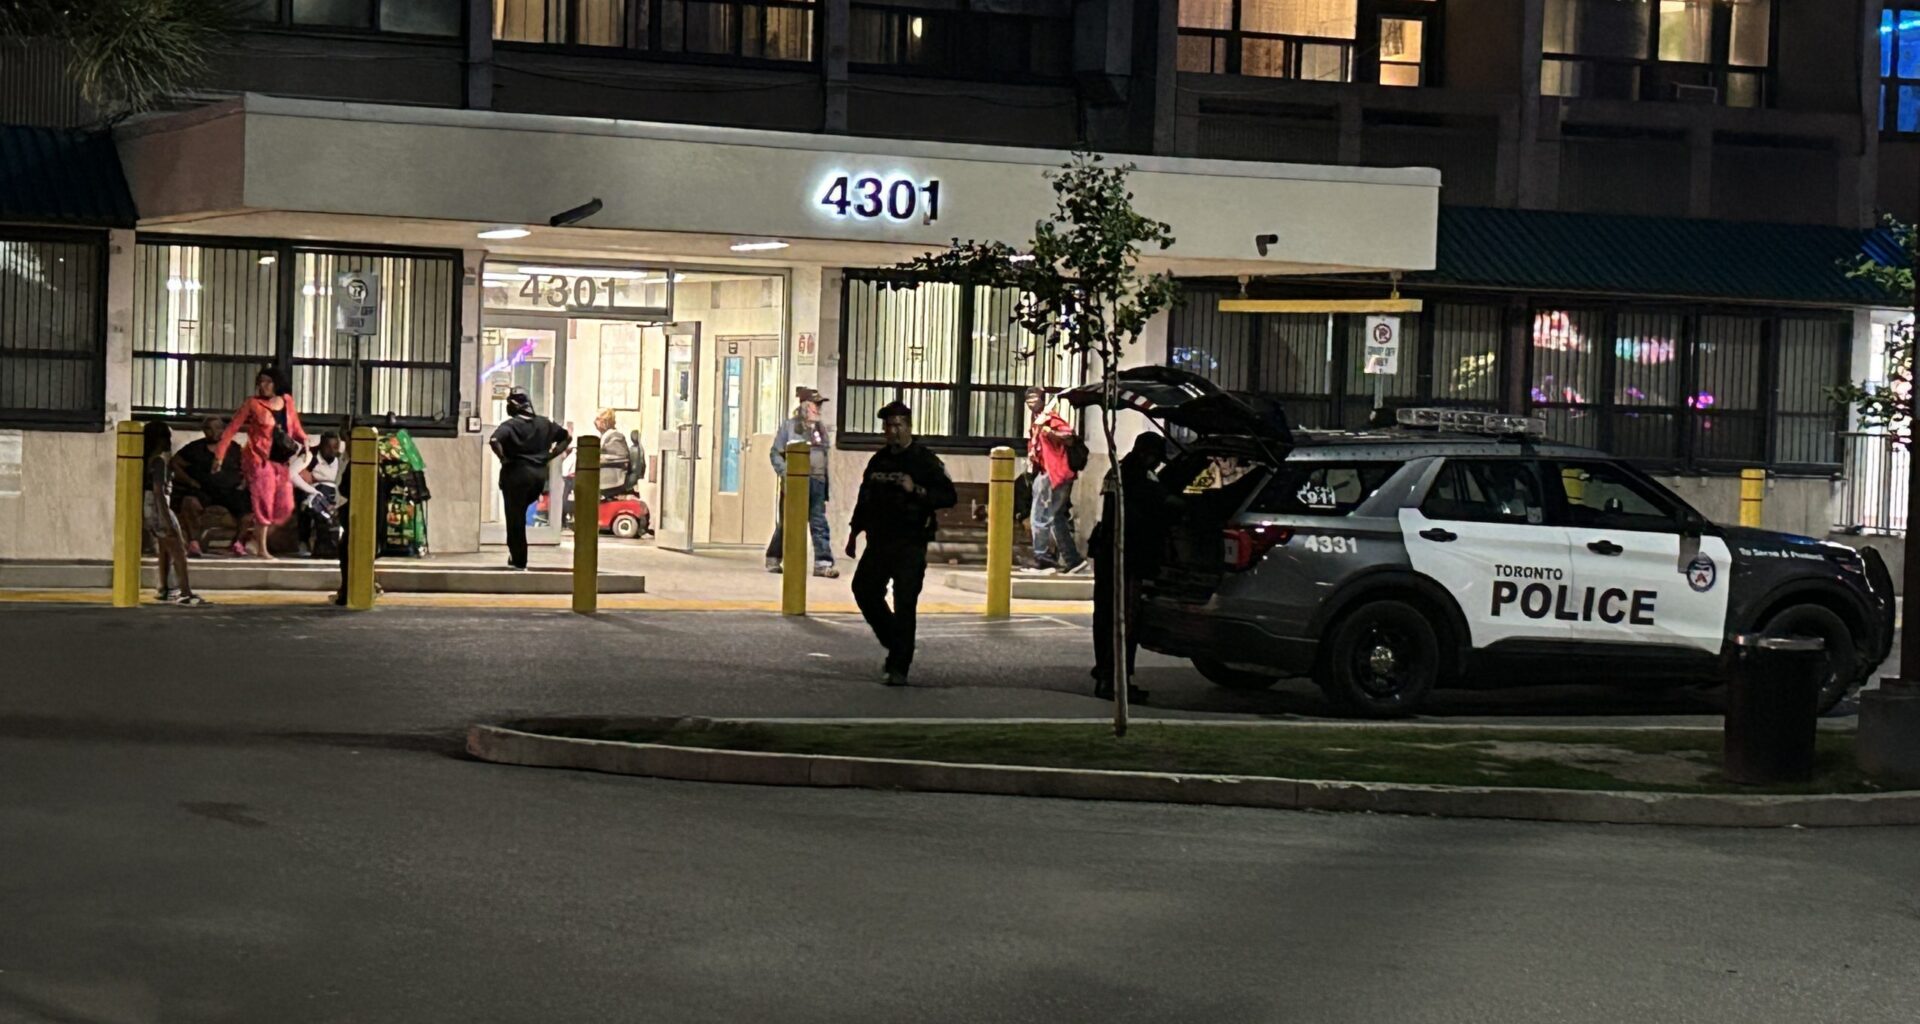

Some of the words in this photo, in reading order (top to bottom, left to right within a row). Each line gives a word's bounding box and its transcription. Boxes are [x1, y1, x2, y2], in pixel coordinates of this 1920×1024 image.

[821, 176, 940, 221] 4301
[519, 274, 616, 308] 4301
[1304, 535, 1358, 554] 4331
[1495, 564, 1563, 581] TORONTO
[1491, 580, 1658, 626] POLICE
